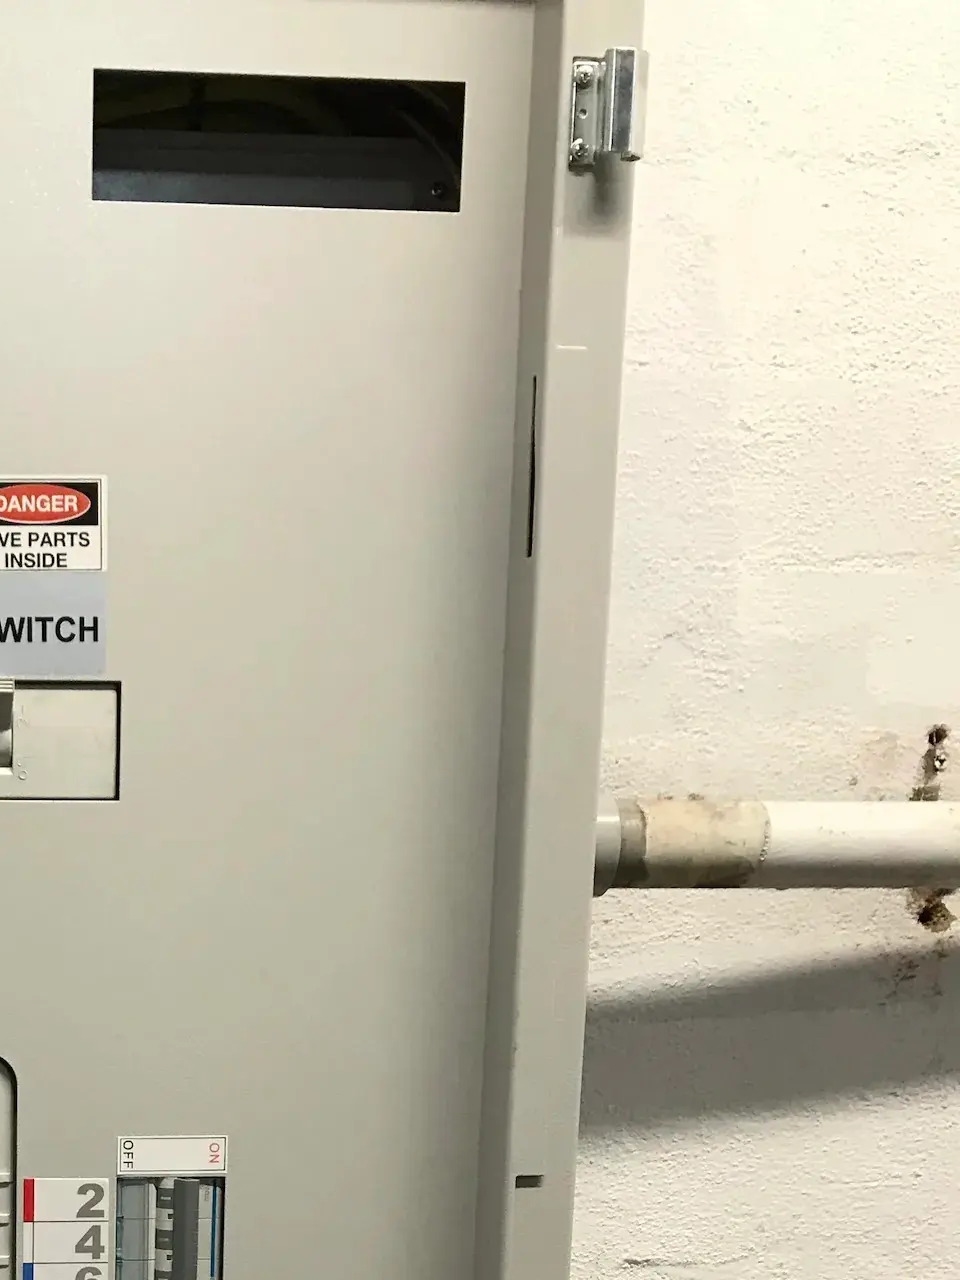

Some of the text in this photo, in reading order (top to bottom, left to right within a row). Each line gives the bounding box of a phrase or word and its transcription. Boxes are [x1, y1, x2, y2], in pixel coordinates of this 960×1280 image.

[28, 532, 90, 547] PARTS
[4, 552, 67, 568] INSIDE
[123, 1140, 134, 1168] OFF
[208, 1143, 220, 1163] ON
[76, 1183, 104, 1218] 2
[75, 1225, 105, 1259] 4
